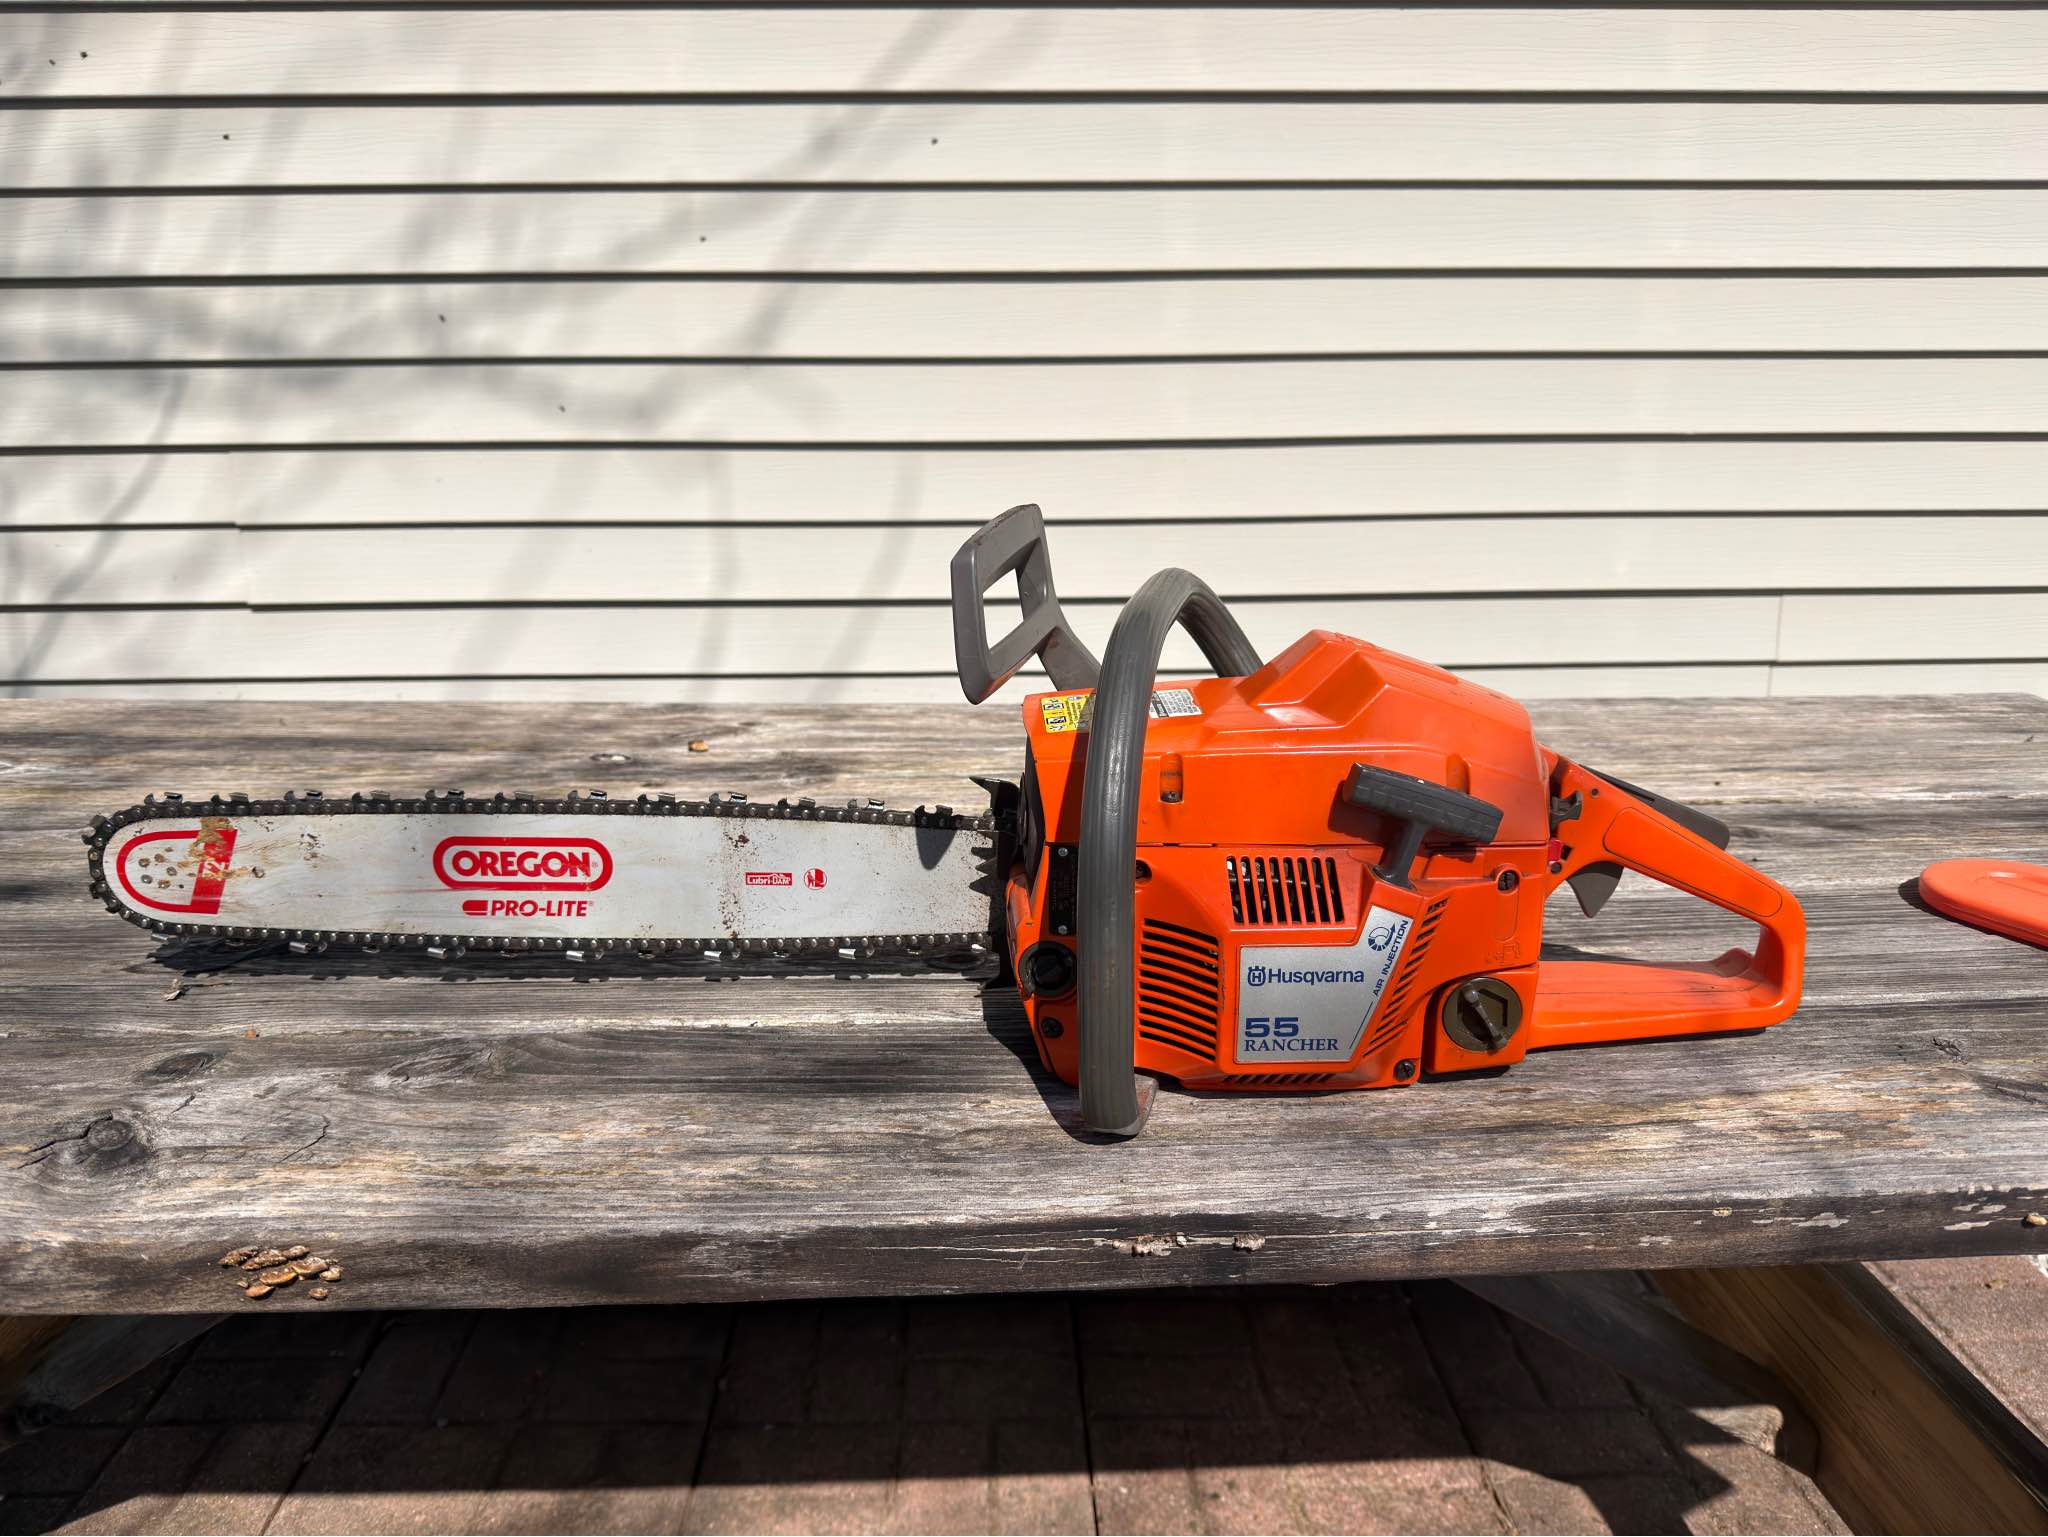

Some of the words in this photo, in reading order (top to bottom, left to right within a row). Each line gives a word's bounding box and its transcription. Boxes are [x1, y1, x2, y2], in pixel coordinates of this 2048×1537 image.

[452, 850, 591, 877] OREGON
[490, 899, 588, 917] PRO-LITE
[1373, 978, 1385, 997] AIR
[1381, 919, 1409, 976] INJECTION
[1268, 967, 1364, 986] Husqvarna
[1244, 1017, 1299, 1038] 55
[1244, 1038, 1339, 1051] RANCHER
